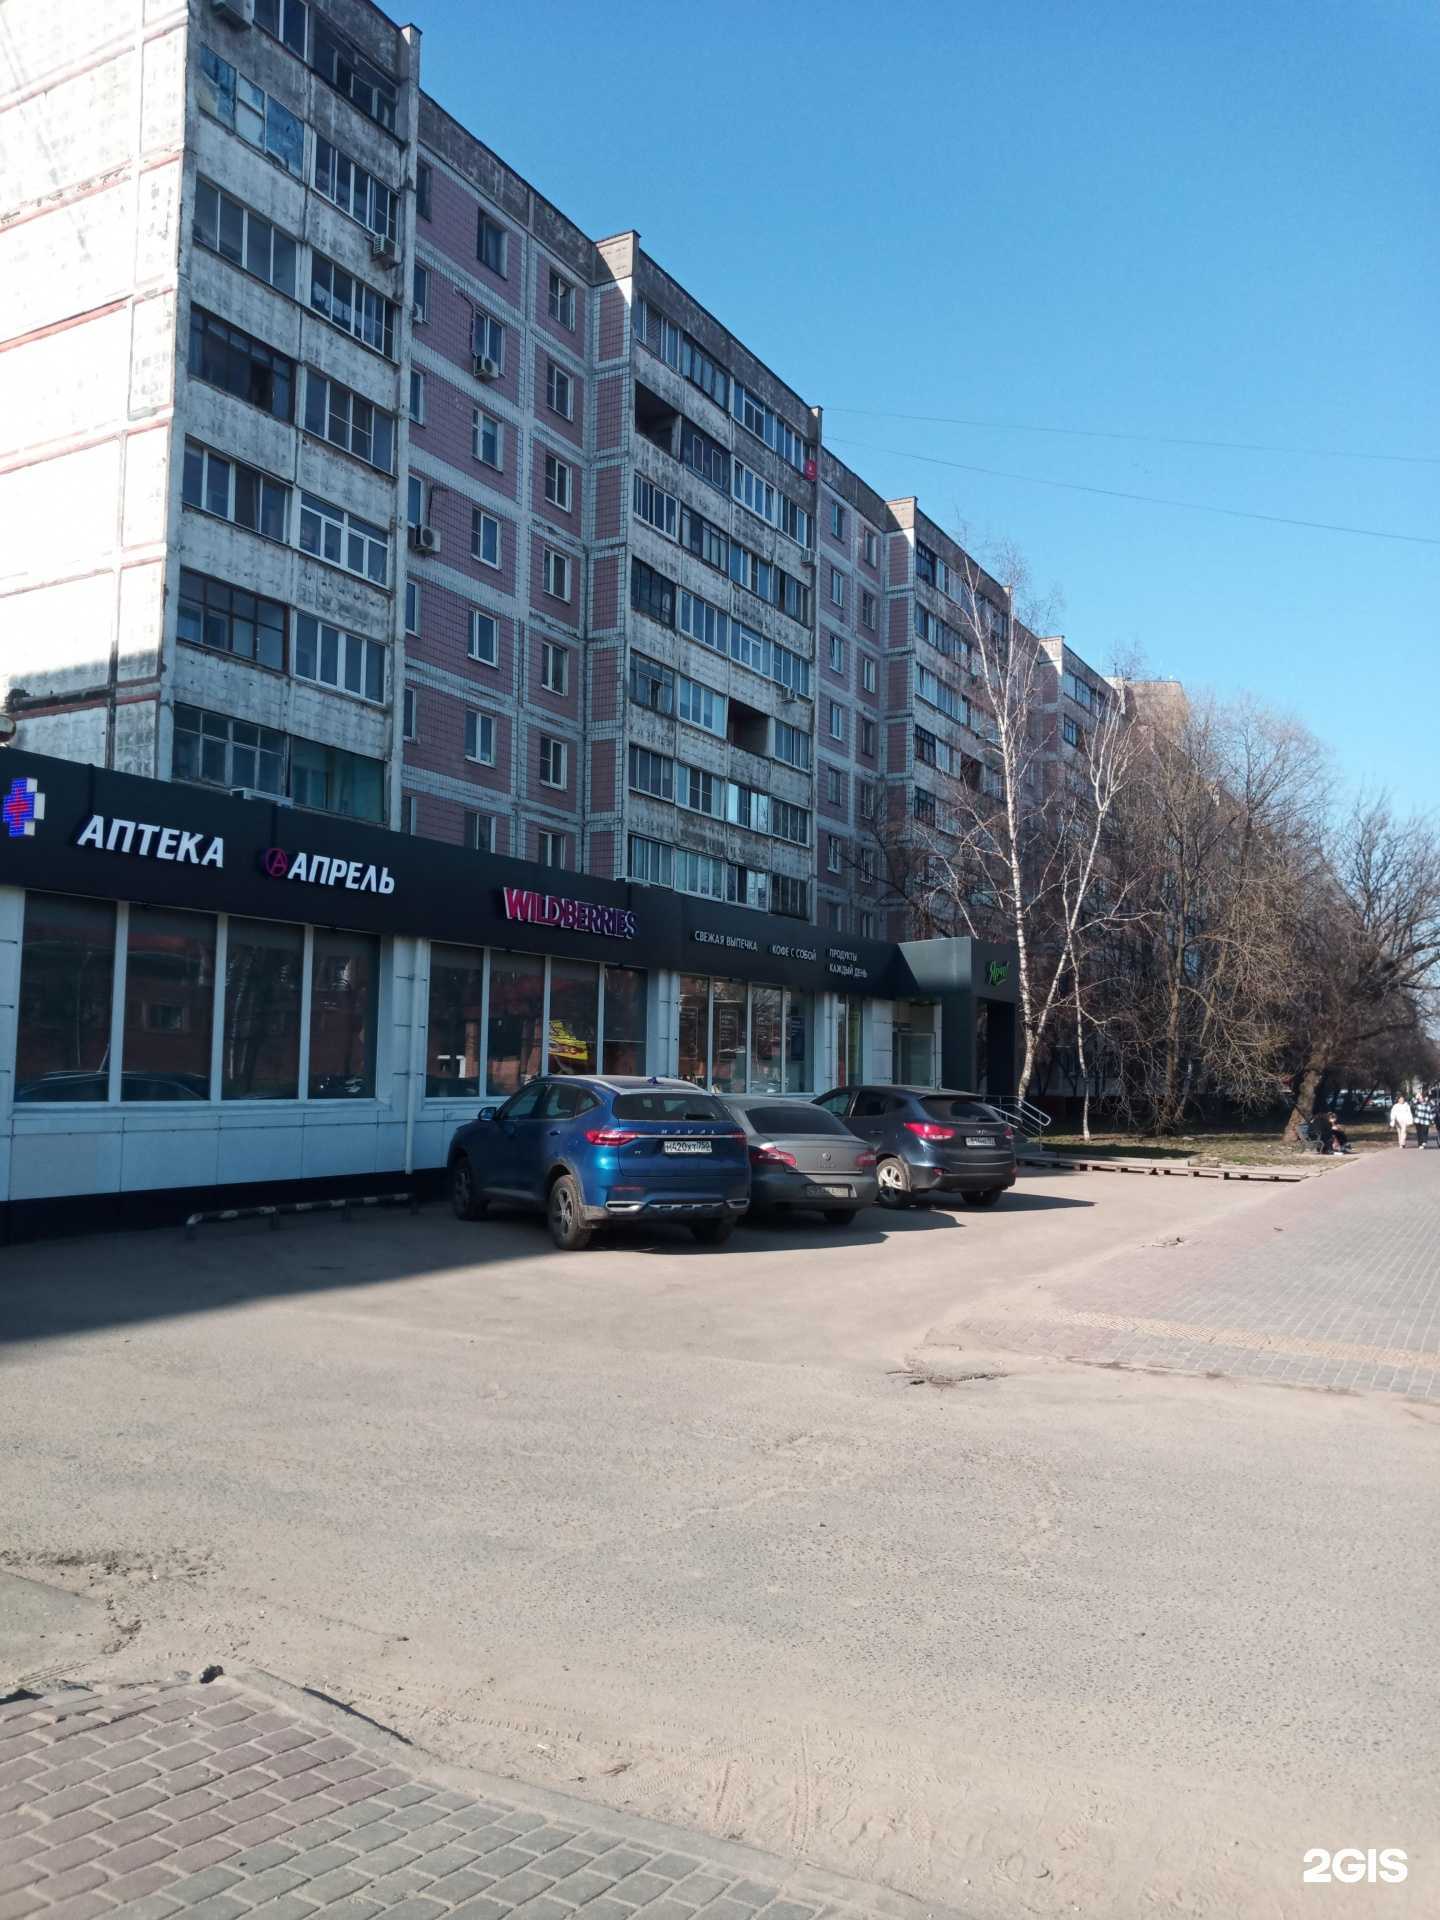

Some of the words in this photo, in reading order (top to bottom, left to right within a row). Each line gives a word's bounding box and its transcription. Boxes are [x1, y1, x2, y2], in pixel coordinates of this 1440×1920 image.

[77, 814, 224, 868] АПТЕКА
[288, 852, 395, 895] АПРЕЛЬ
[503, 887, 639, 939] WILDBERRIES
[695, 930, 725, 945] СВЕЖАЯ
[726, 936, 758, 951] ВЫПЕЧКА
[772, 945, 789, 956] КОФЕ
[796, 948, 817, 961] СОБОЙ
[829, 948, 857, 962] ПРОДУКТЫ
[829, 963, 854, 977] КАЖДЫЙ
[854, 967, 868, 979] ДЕНЬ
